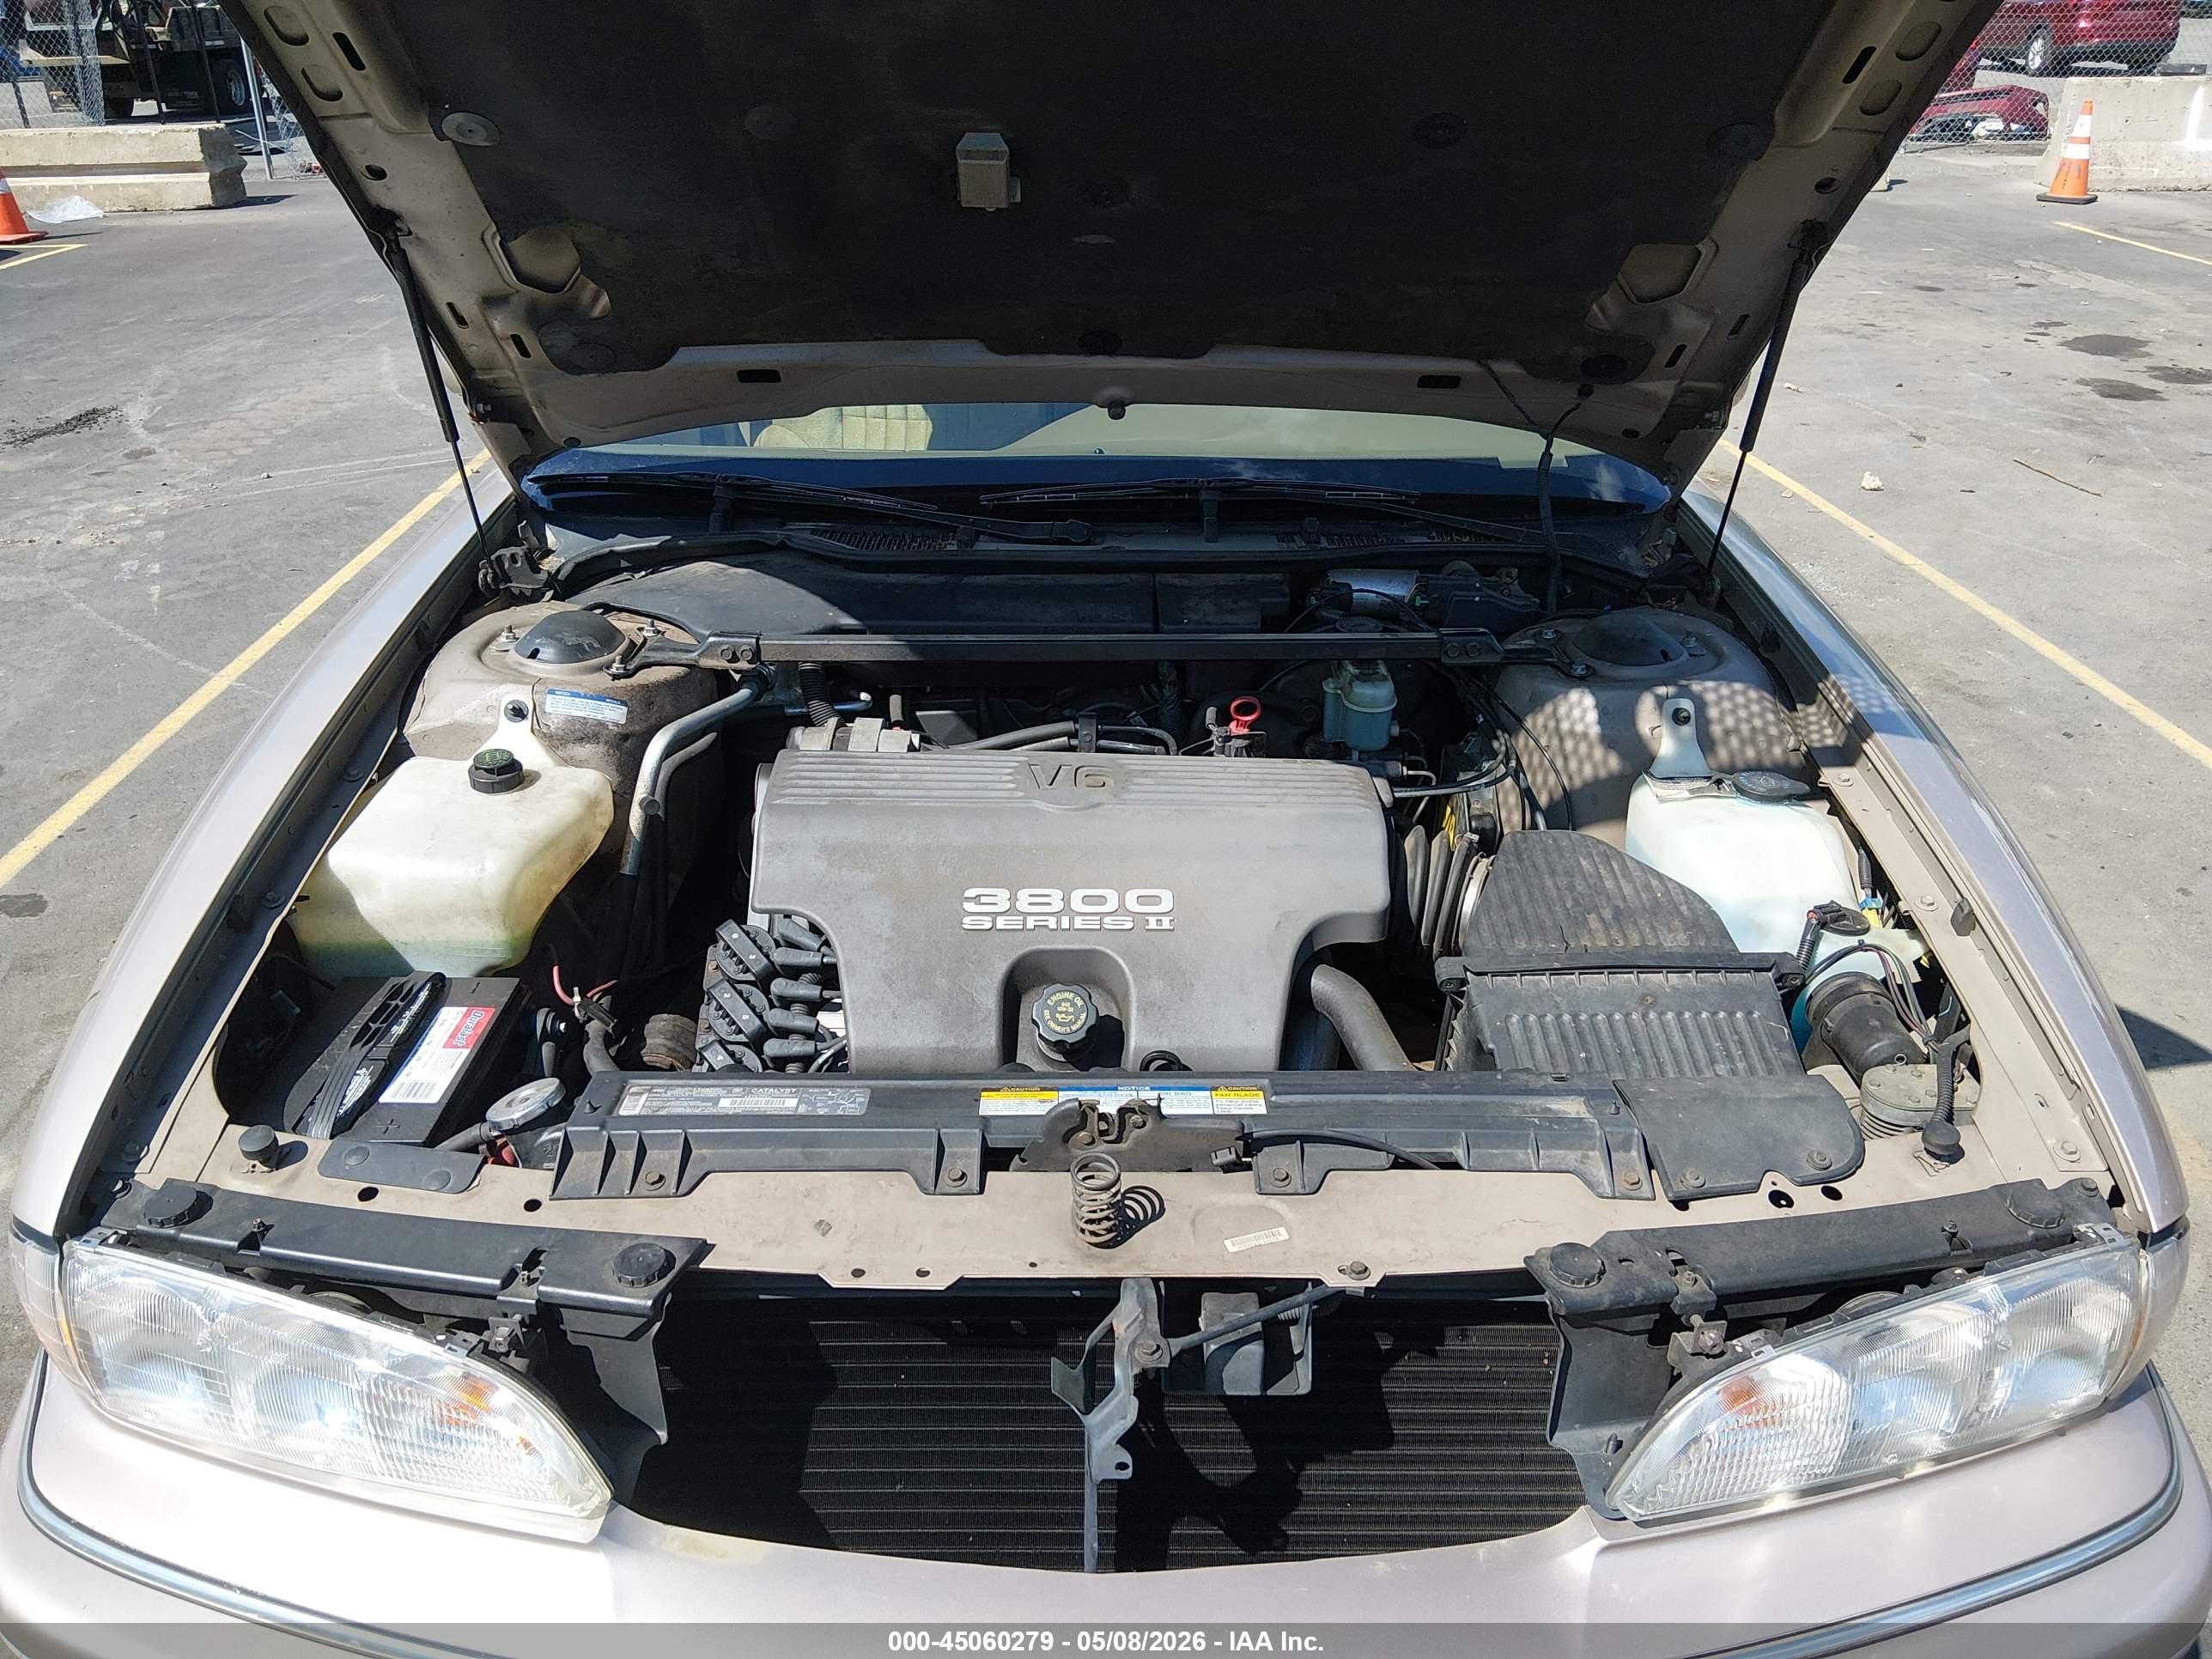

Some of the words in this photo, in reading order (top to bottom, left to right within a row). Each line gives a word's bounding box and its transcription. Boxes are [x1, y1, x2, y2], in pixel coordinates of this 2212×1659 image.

[1028, 763, 1114, 790] V6
[963, 887, 1175, 914] 3800
[961, 915, 1135, 931] SERIES
[1145, 916, 1175, 931] II
[1047, 991, 1075, 1006] ENGINE
[1073, 996, 1085, 1008] OIL
[452, 1009, 486, 1047] Duralast
[1070, 1012, 1086, 1031] MANUAL
